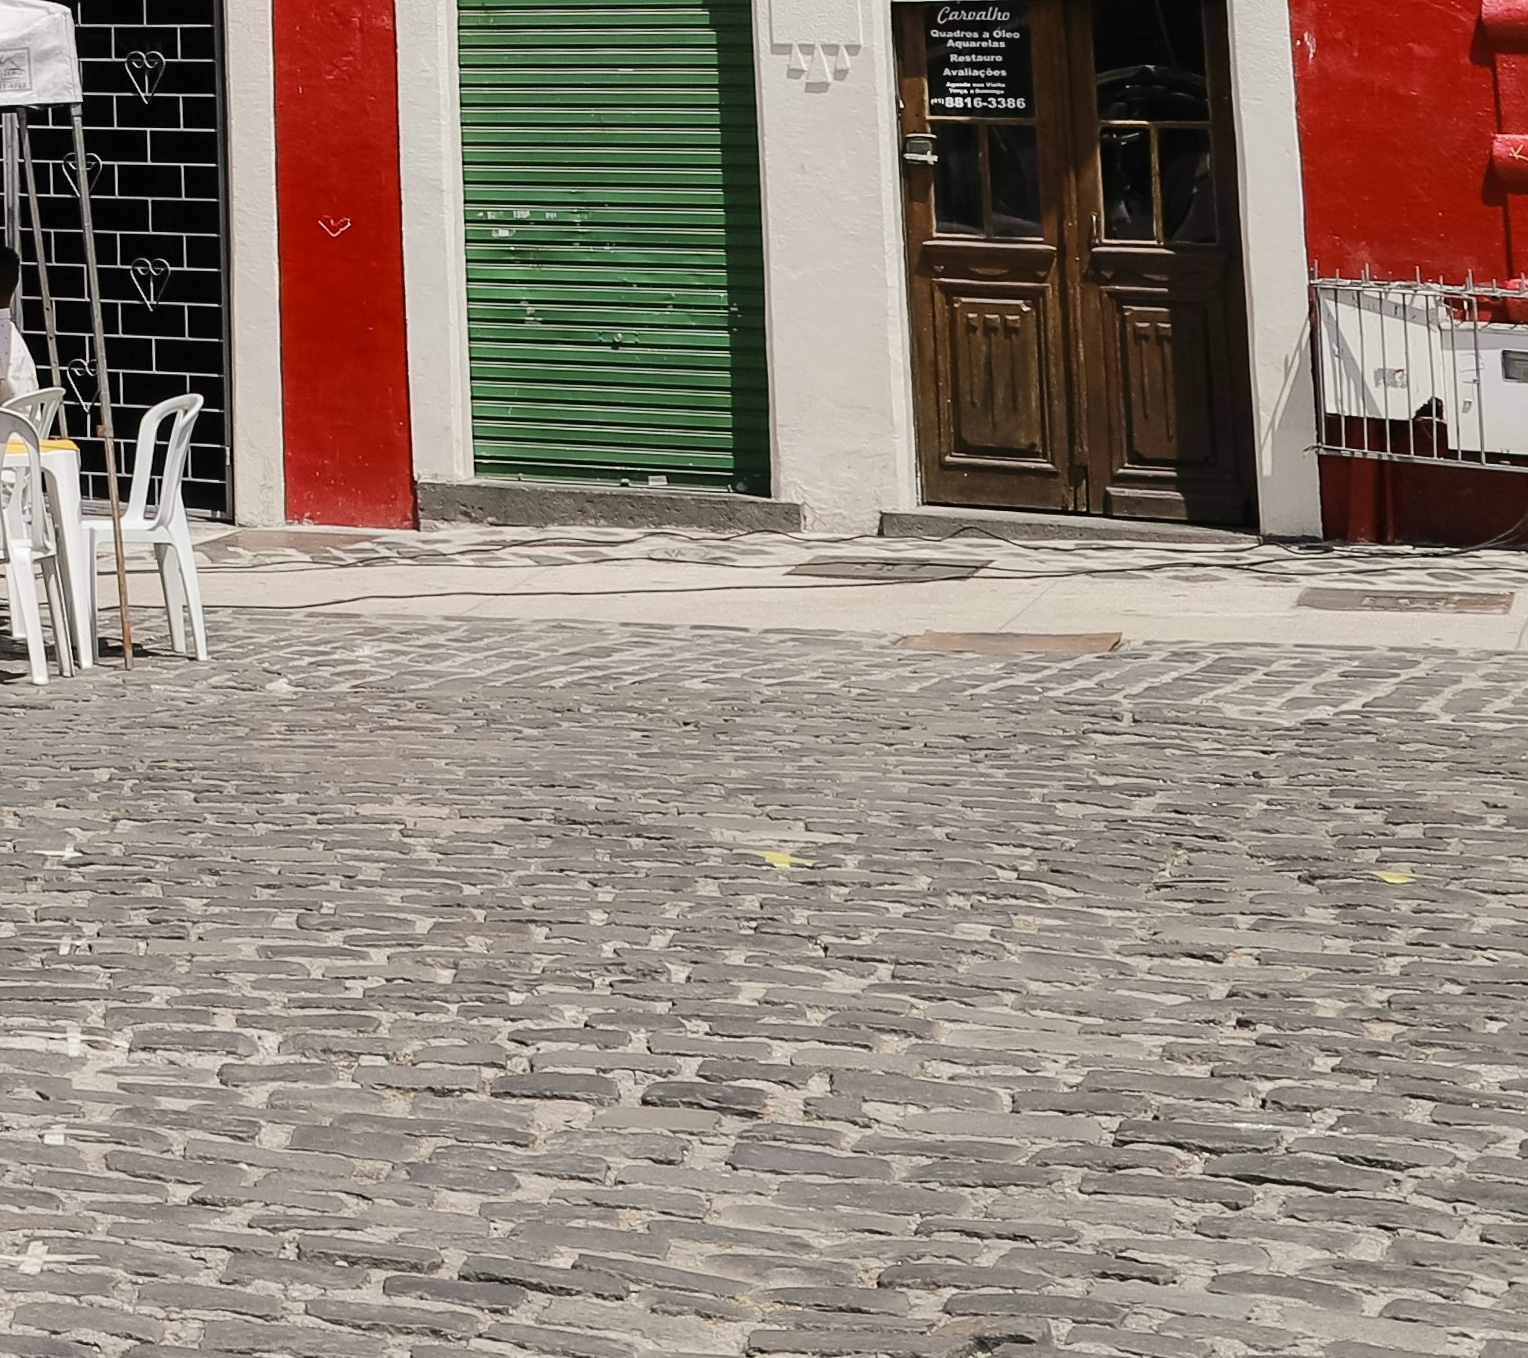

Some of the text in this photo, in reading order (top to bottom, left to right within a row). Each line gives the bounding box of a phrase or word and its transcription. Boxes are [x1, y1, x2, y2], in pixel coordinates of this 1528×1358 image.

[937, 6, 1010, 24] Carvalho
[930, 29, 979, 38] Quadros
[992, 26, 1020, 38] Óleo
[946, 39, 1006, 49] Aquarelas
[949, 53, 1003, 62] Restauro
[942, 68, 1007, 78] Avaliações
[945, 96, 1026, 108] 8816-3386
